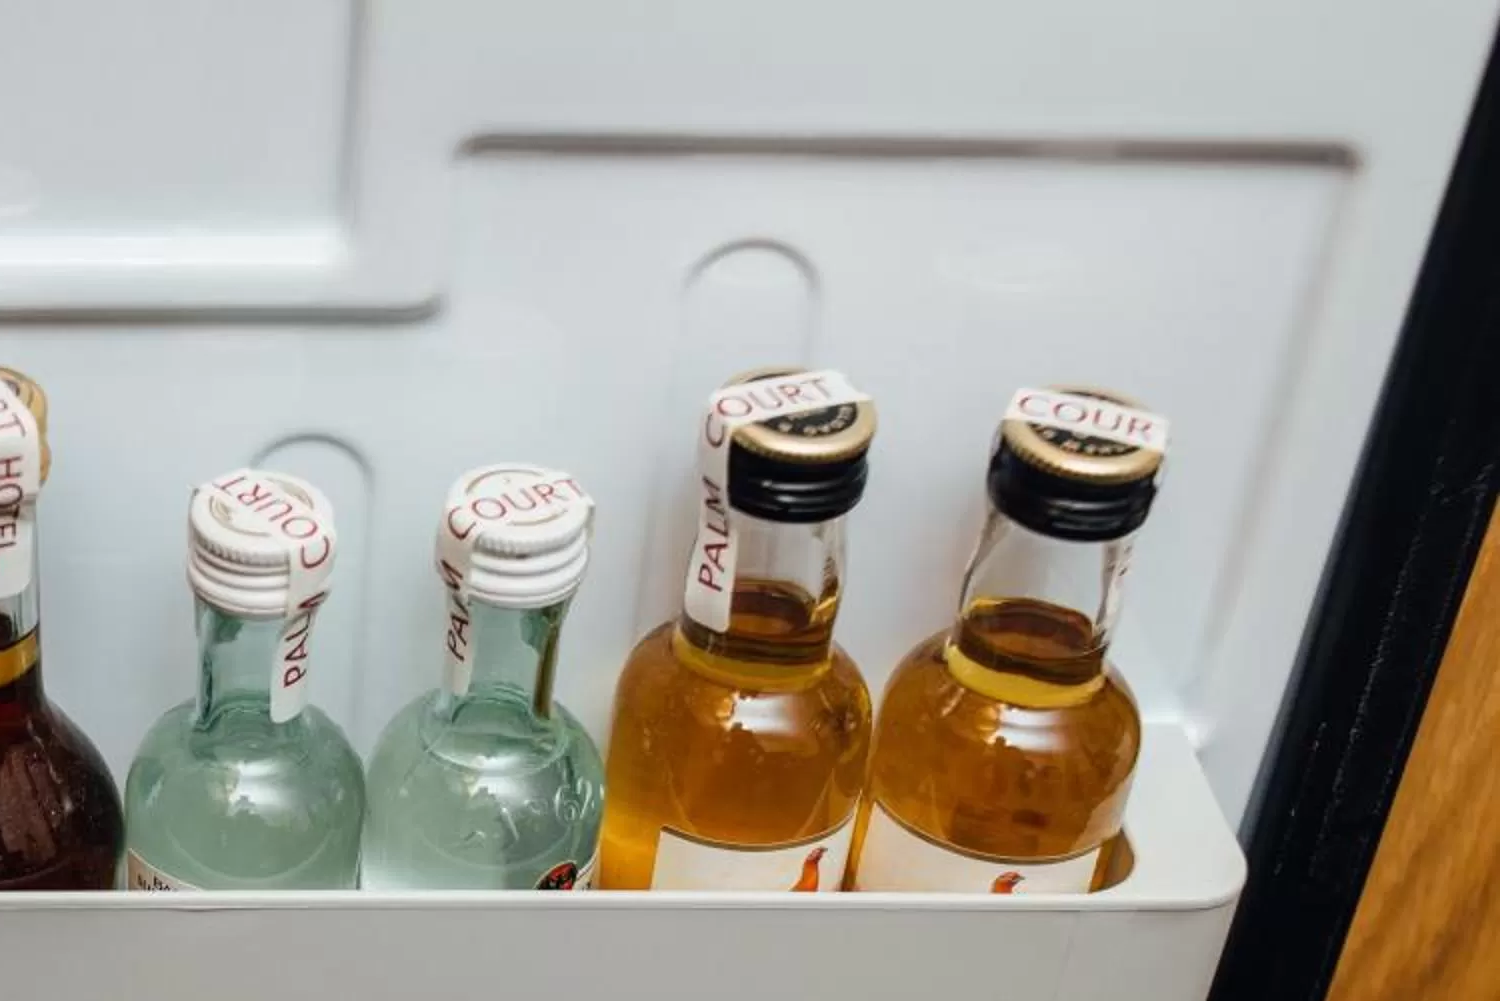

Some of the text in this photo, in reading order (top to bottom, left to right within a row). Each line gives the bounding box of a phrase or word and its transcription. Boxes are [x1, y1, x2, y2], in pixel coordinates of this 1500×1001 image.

[705, 377, 833, 447] COURT
[212, 476, 331, 569] COURT
[447, 479, 584, 541] COURT
[697, 475, 729, 592] PALM
